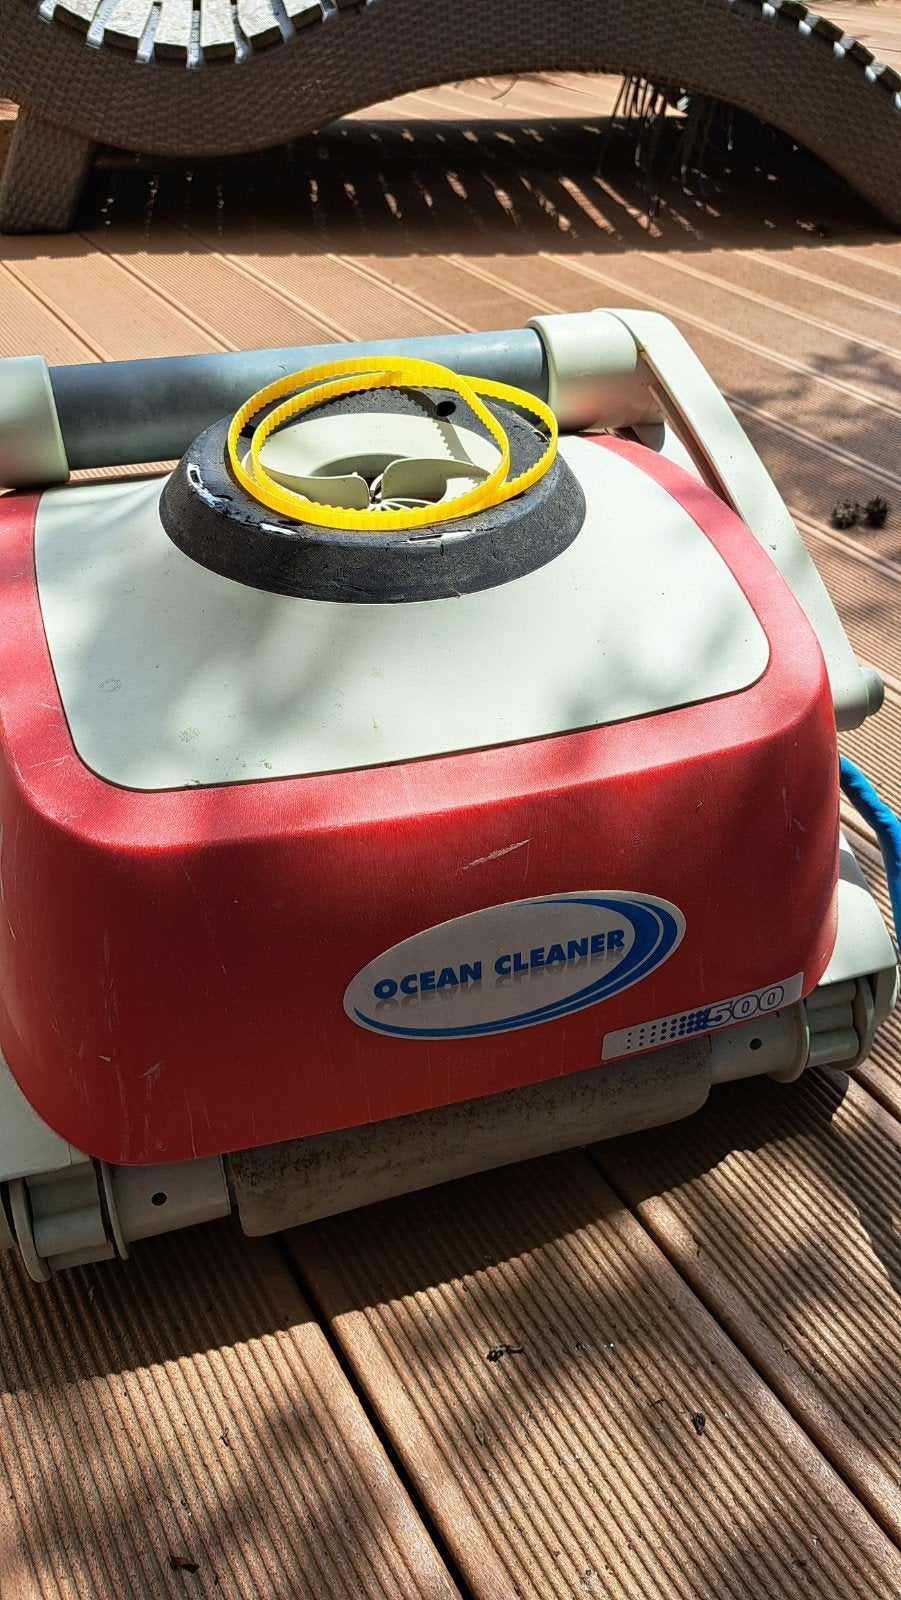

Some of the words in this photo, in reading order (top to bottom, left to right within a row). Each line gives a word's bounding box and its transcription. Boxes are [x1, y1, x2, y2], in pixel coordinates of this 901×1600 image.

[373, 961, 482, 1000] OCEAN
[494, 928, 625, 975] CLEANER
[706, 985, 785, 1028] 500
